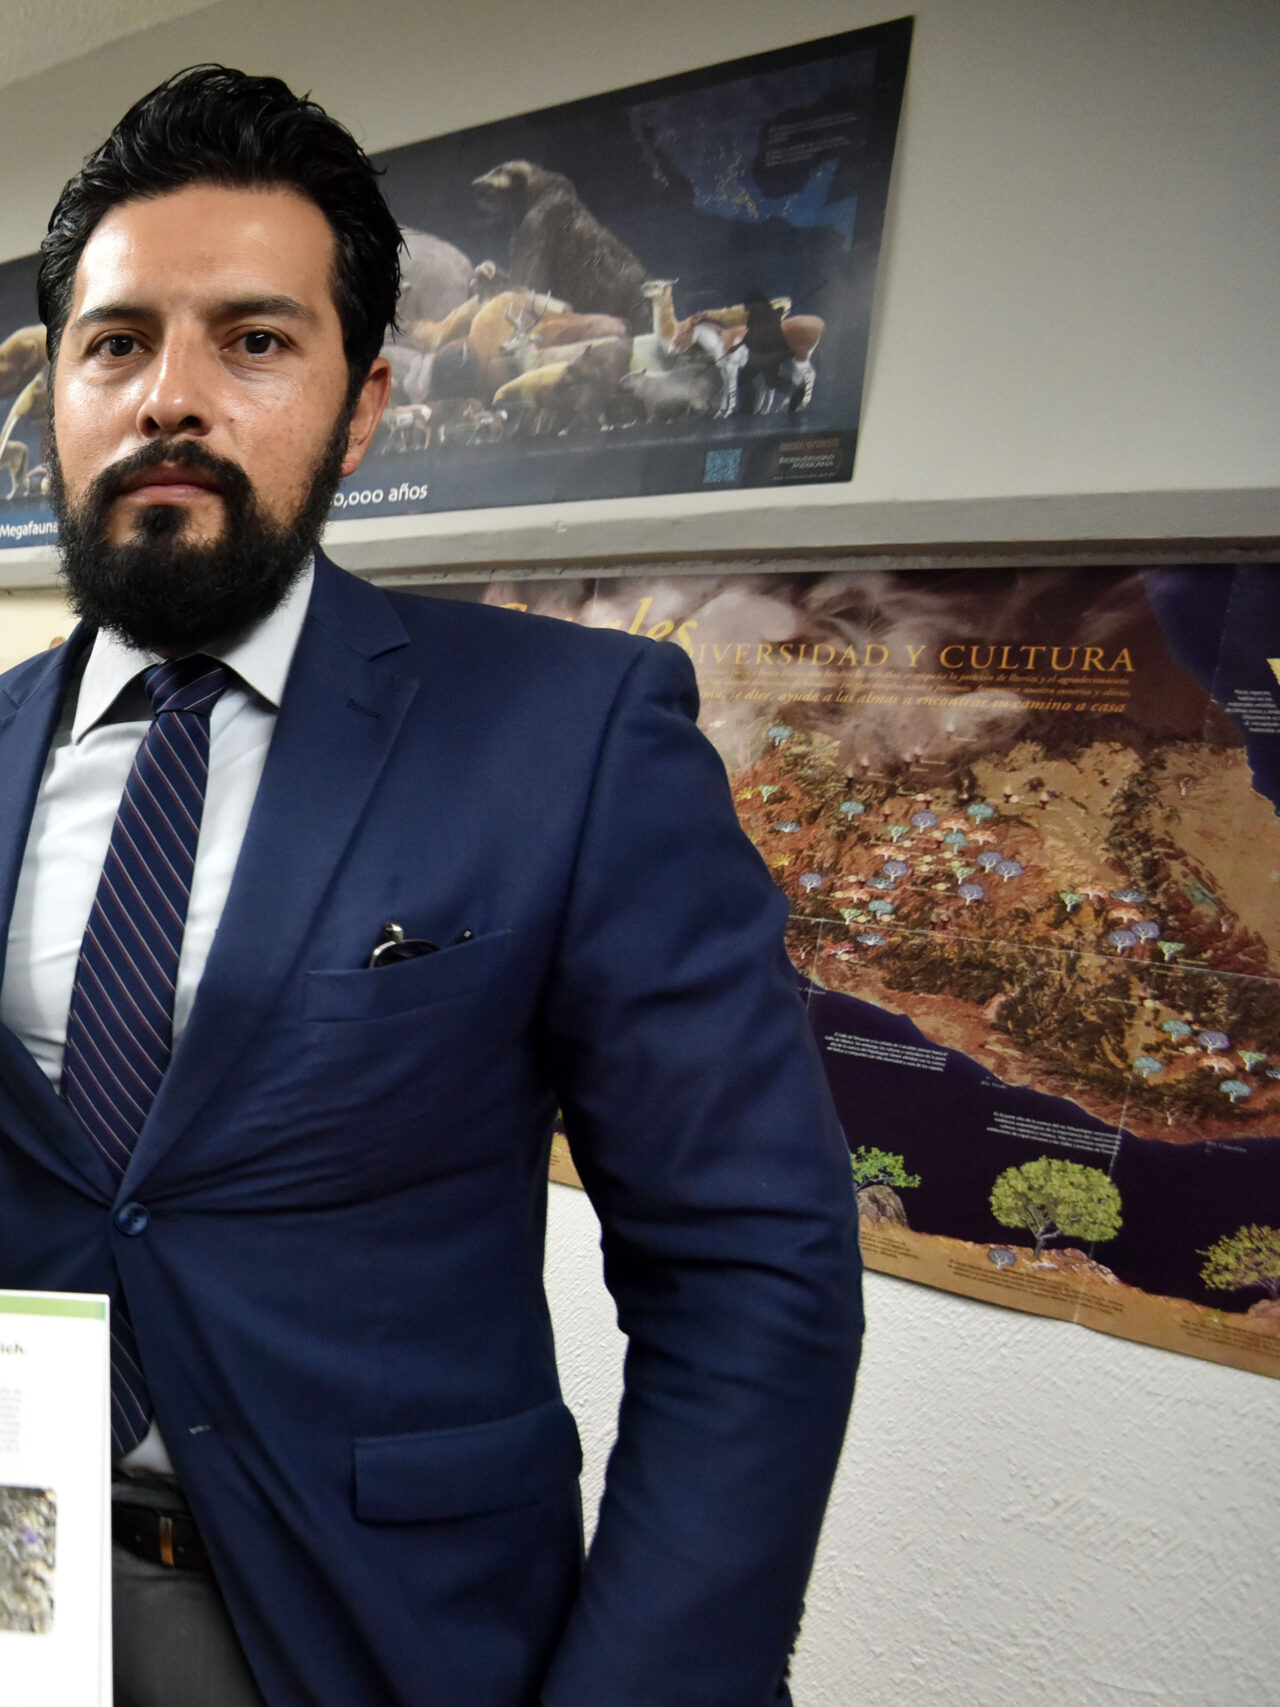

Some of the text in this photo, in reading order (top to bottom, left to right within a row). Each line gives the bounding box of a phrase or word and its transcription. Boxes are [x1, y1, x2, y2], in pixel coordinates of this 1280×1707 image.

[331, 482, 428, 509] 0,000 años
[697, 641, 1135, 673] IVERSIDAD Y CULTURA
[777, 689, 820, 704] ayuda
[823, 694, 832, 702] a
[857, 691, 899, 705] almas
[902, 695, 913, 705] a
[1011, 698, 1072, 711] camino
[1075, 701, 1087, 712] a
[1090, 702, 1126, 713] casa
